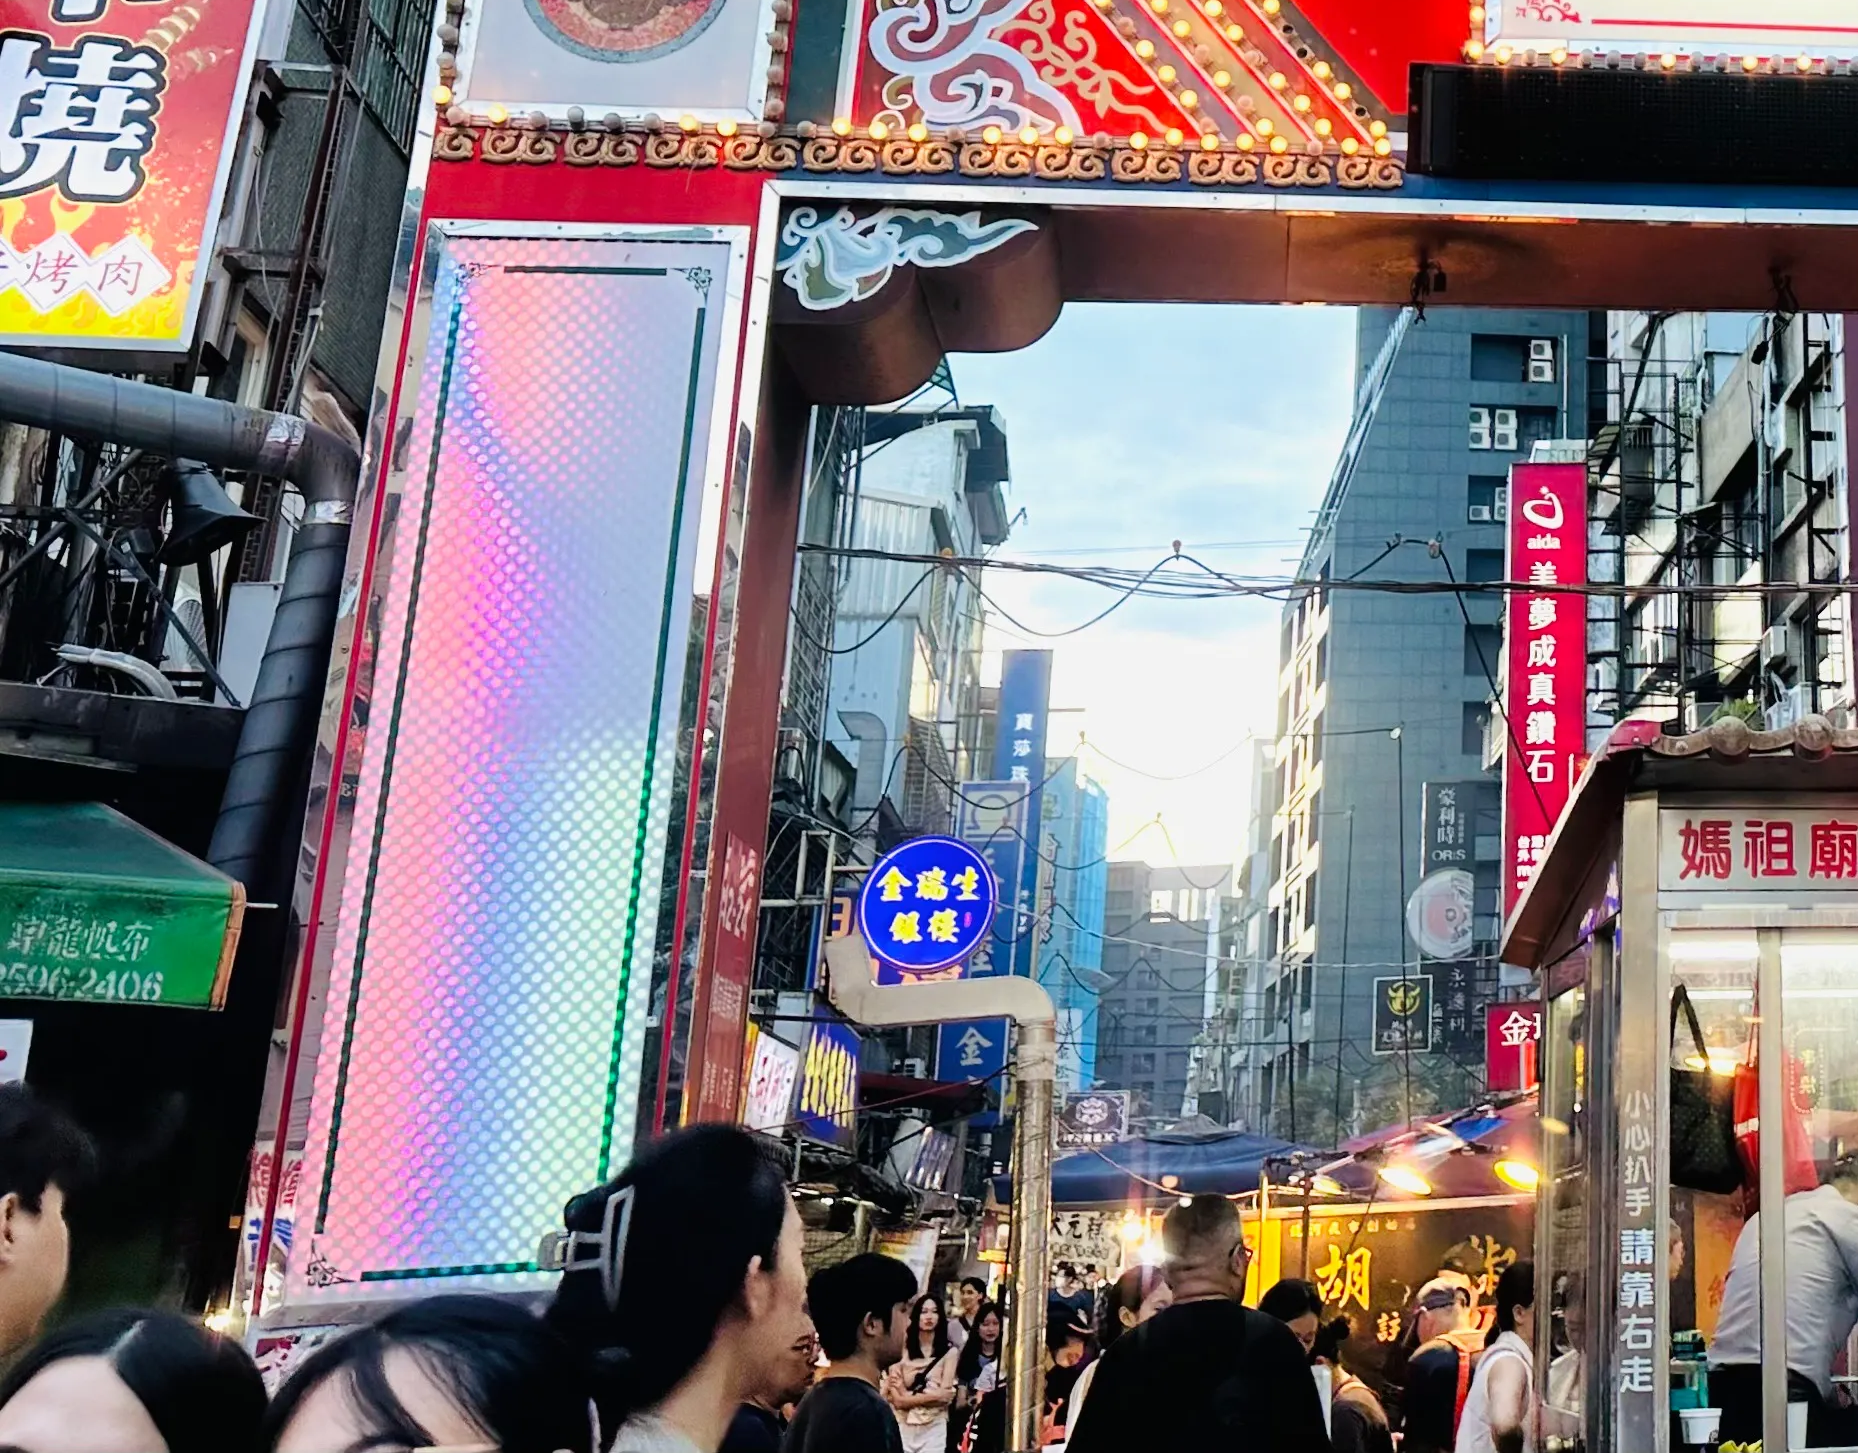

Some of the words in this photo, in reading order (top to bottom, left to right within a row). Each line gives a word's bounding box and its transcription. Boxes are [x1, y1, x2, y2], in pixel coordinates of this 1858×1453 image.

[0, 248, 144, 297] 烤肉
[1527, 559, 1558, 785] 美夢成真鑽石
[955, 1026, 993, 1066] 金
[1623, 1089, 1652, 1217] 小心扒手
[1619, 1228, 1655, 1394] 請靠右走
